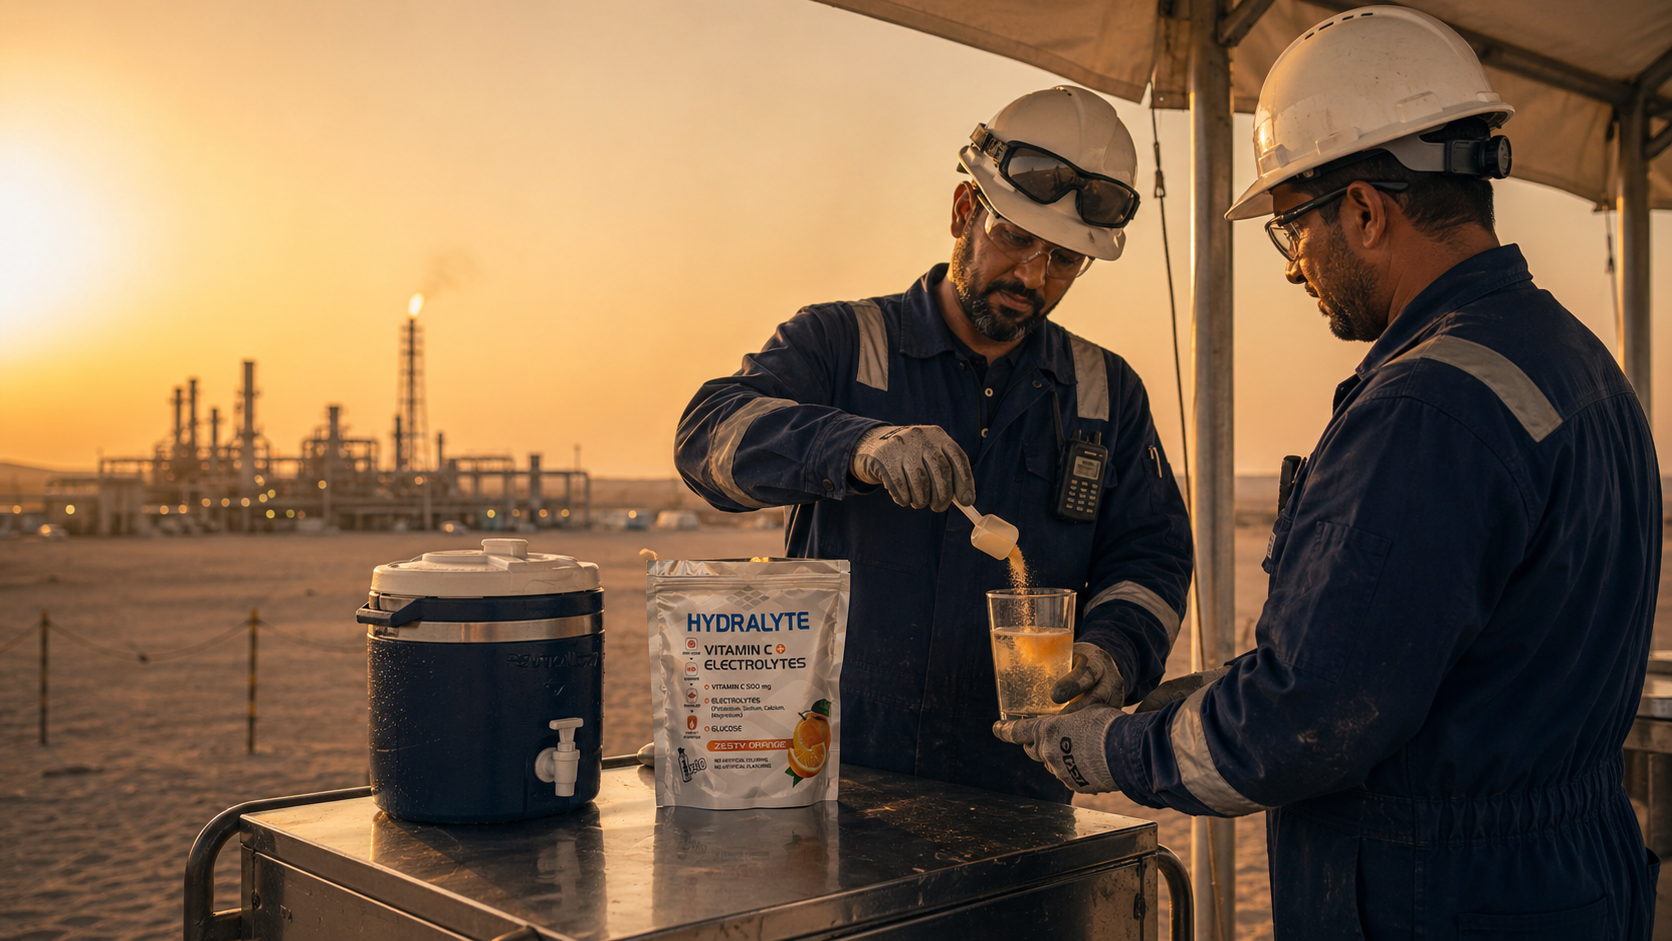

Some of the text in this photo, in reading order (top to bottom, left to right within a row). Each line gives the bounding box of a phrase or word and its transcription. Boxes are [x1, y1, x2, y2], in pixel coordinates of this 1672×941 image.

[687, 611, 810, 633] HYDRALYTE
[704, 644, 772, 656] VITAMIN C
[704, 658, 806, 671] ELECTROLYTES
[748, 741, 786, 749] ORANGE
